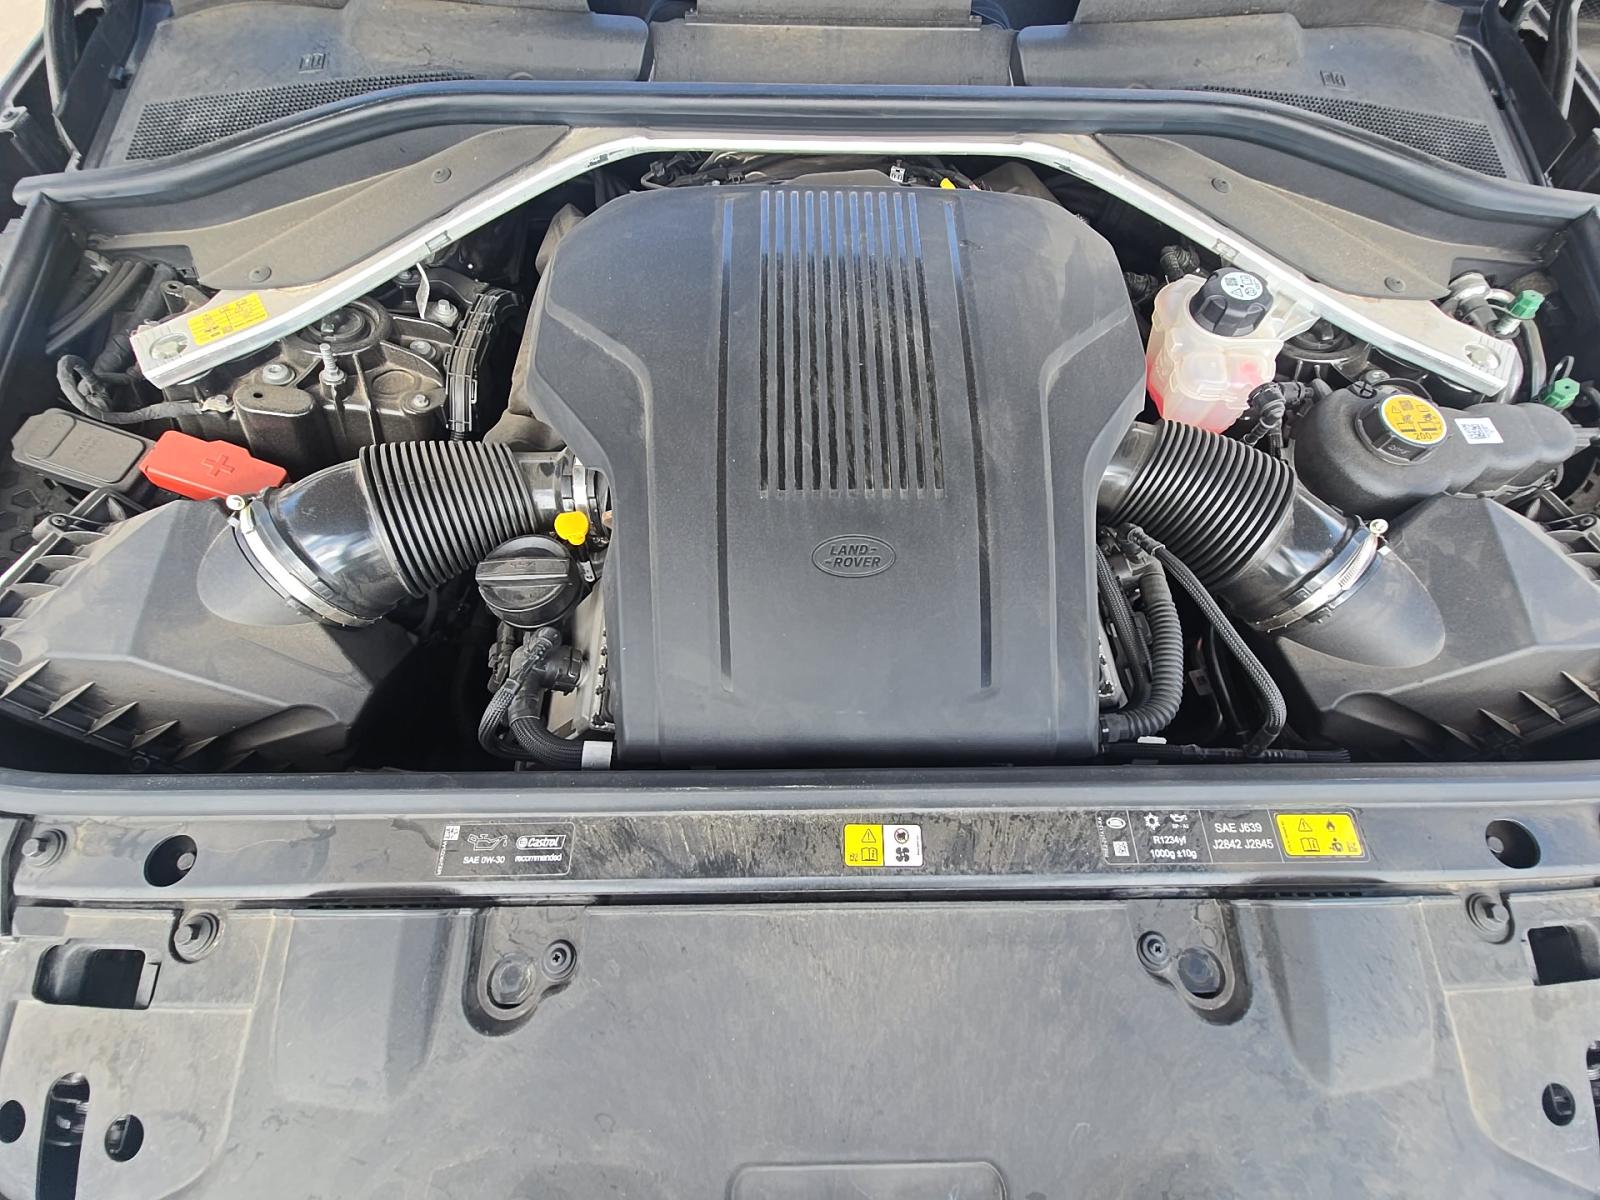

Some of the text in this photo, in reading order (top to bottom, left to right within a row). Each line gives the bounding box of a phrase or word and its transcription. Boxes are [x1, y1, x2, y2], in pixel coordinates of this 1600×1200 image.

[1214, 822, 1263, 833] SAE J639
[527, 836, 559, 848] Castrol
[1152, 835, 1187, 846] R1234yf
[1213, 838, 1274, 850] J2842 J2845
[463, 855, 506, 864] SAE 0W-30
[514, 853, 562, 862] recommended
[1150, 849, 1198, 860] 1000g ±10g
